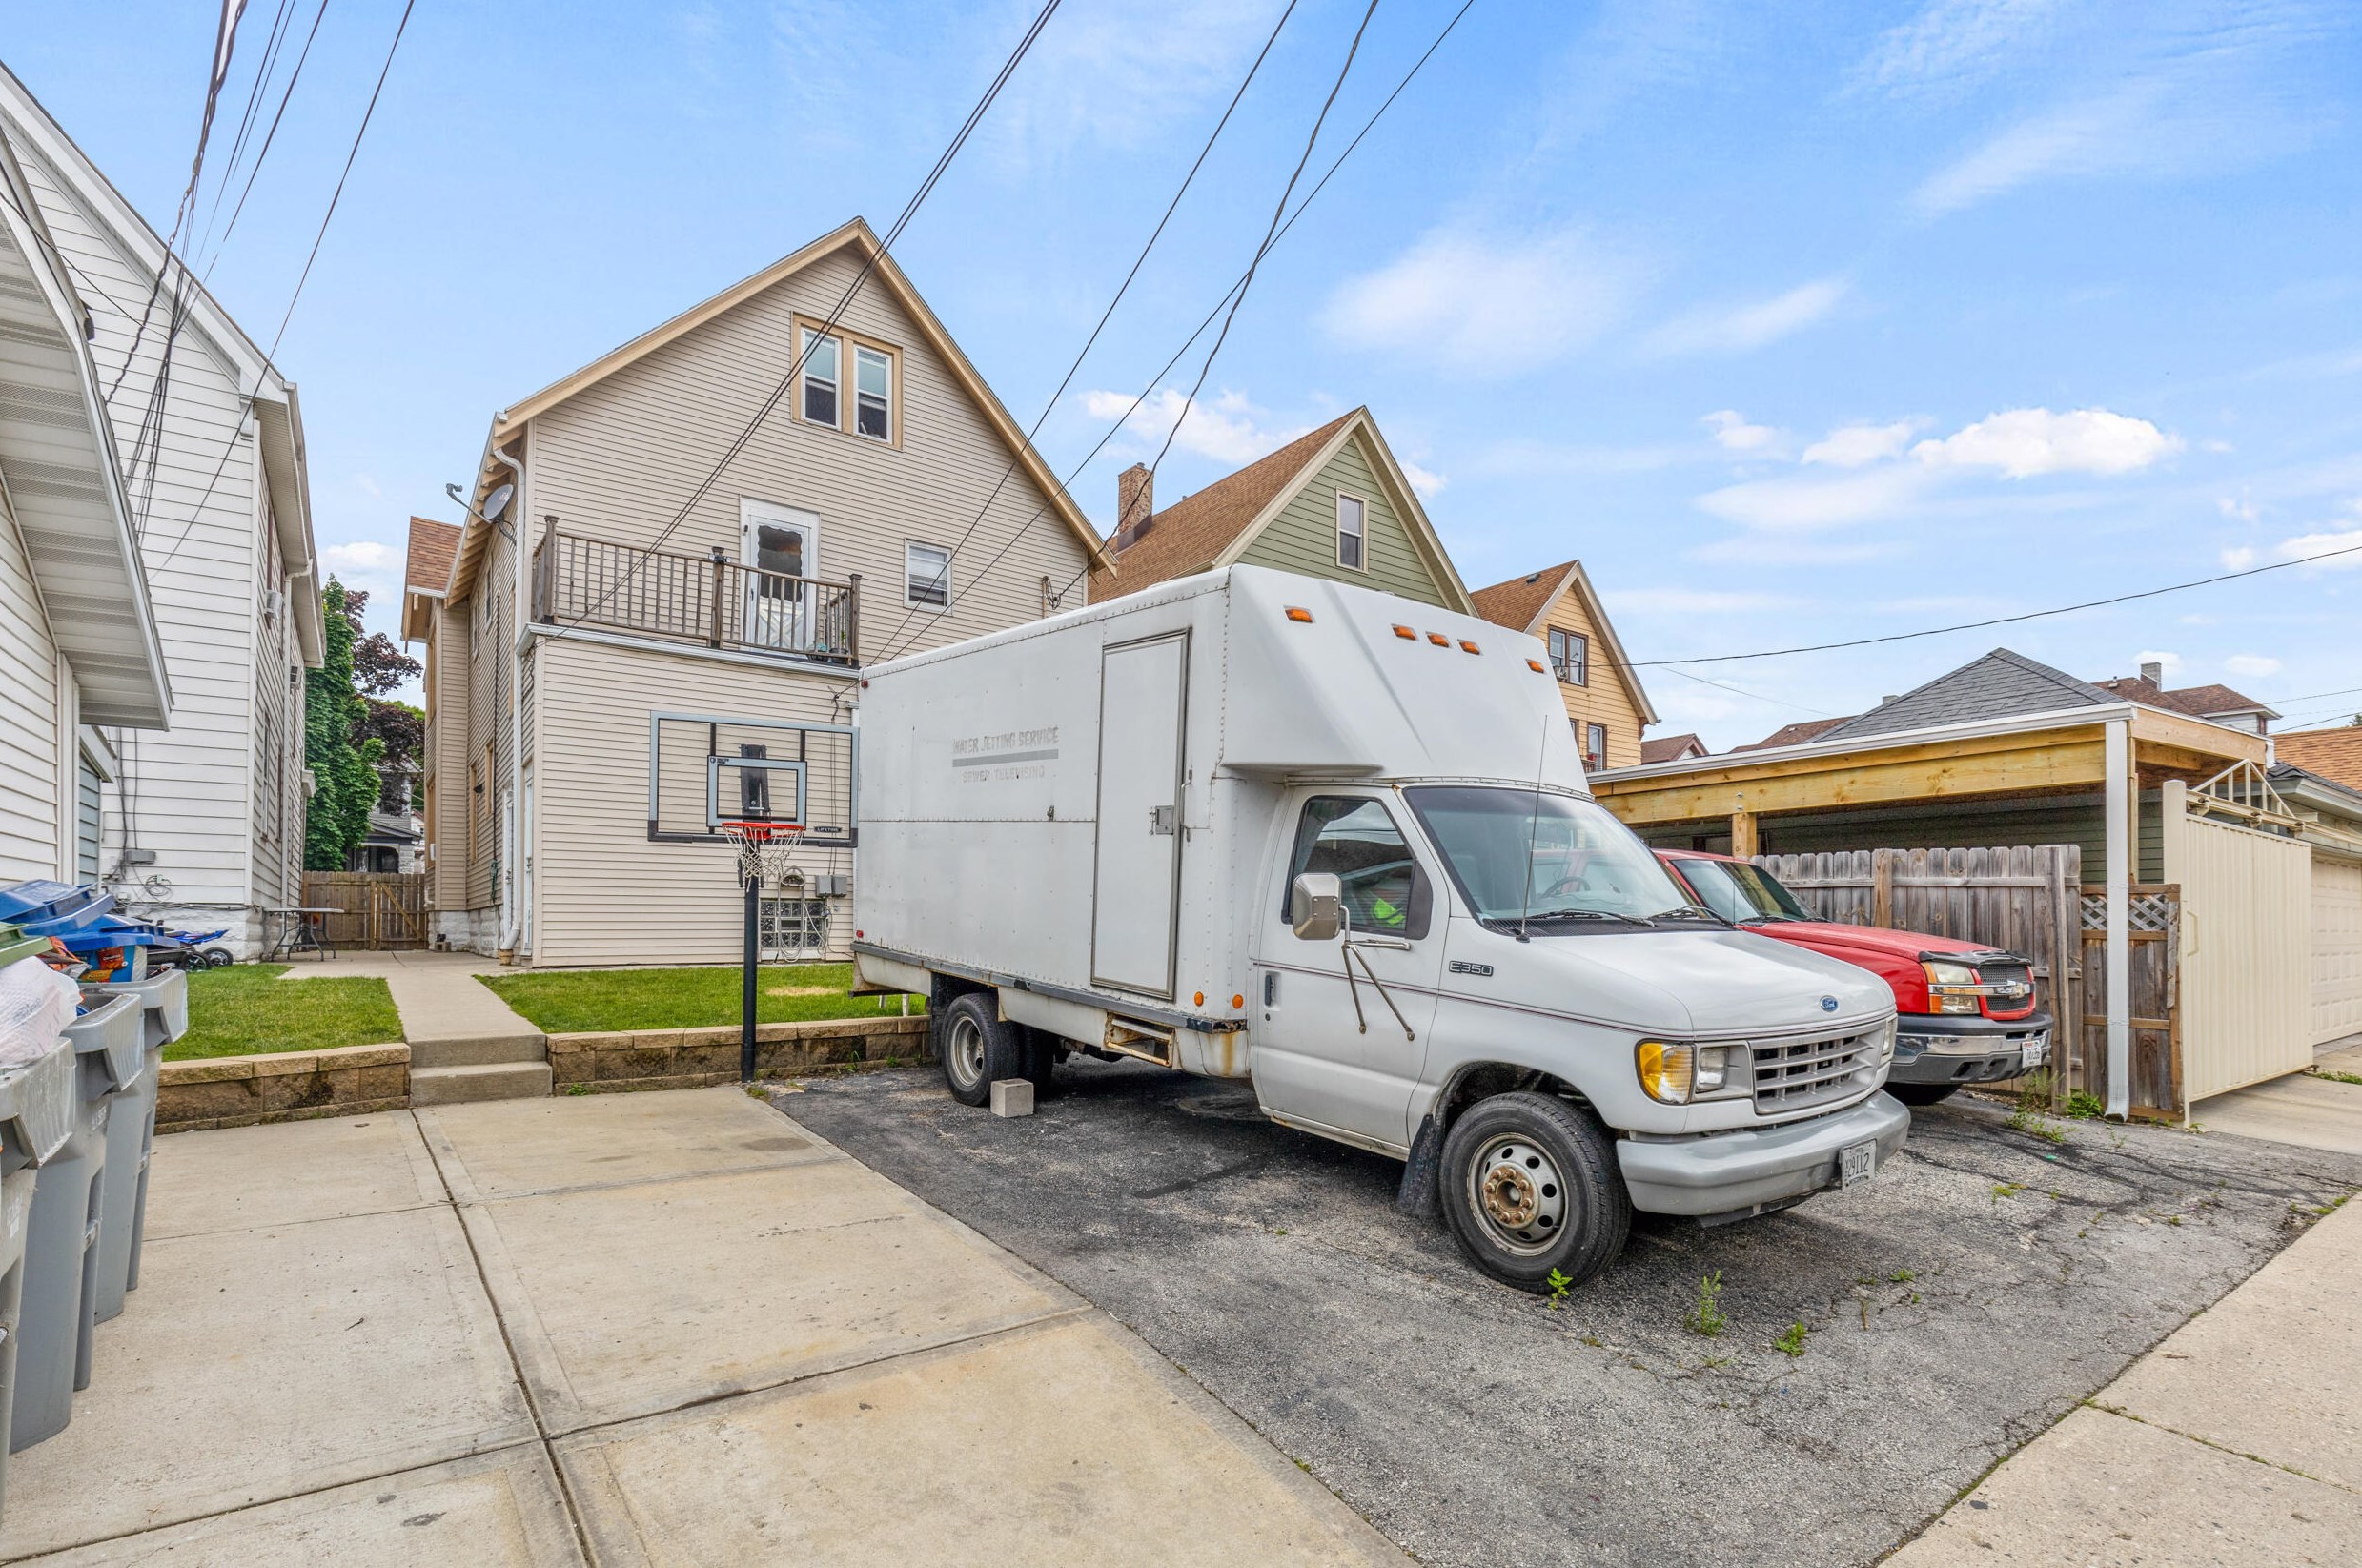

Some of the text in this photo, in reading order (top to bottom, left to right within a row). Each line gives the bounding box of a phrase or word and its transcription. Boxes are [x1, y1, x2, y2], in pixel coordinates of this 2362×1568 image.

[953, 725, 1059, 754] WATER JETTING SERVICE
[962, 764, 1045, 783] SEWER TELEVISING
[1449, 961, 1493, 976] E350
